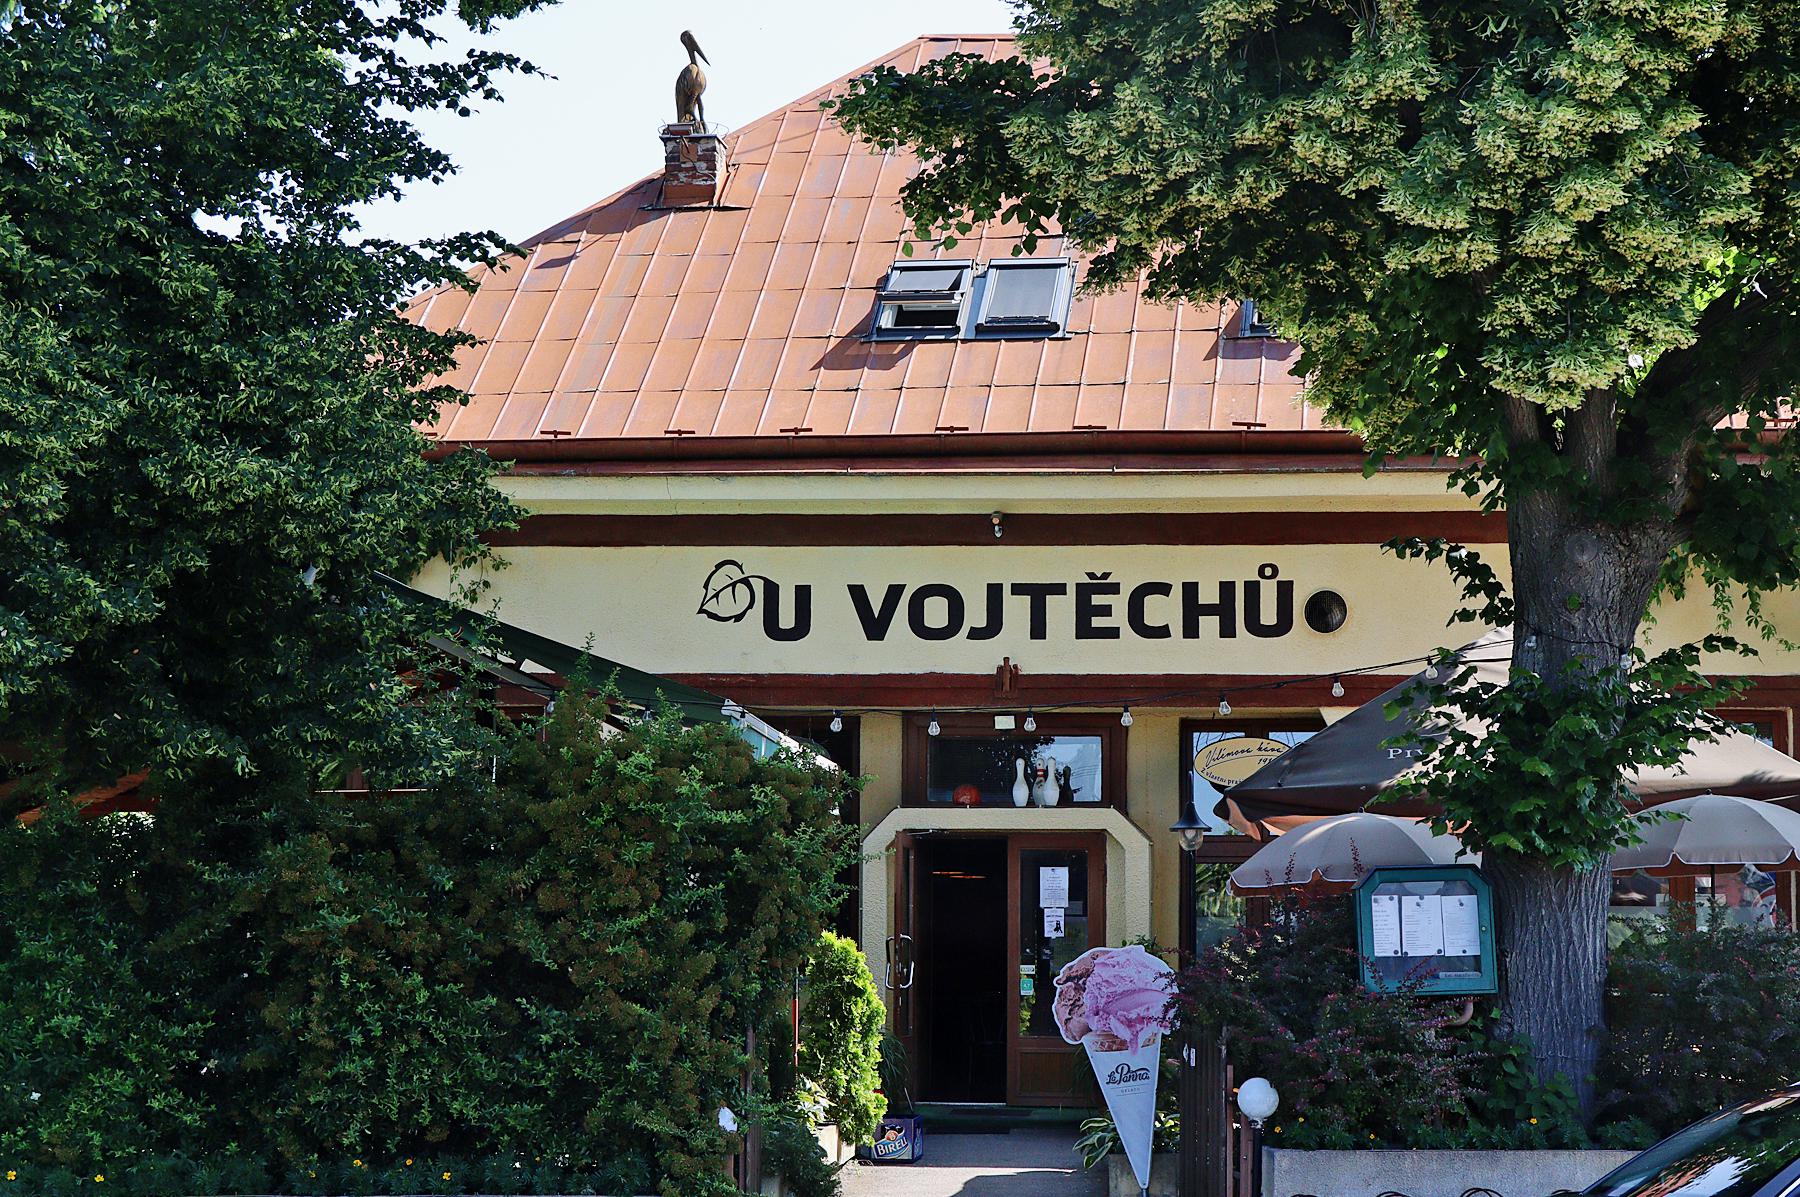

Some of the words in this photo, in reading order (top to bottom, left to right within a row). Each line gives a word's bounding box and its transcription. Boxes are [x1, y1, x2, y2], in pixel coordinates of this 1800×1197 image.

[763, 584, 812, 642] U
[846, 562, 1295, 642] VOJTĚCHŮ
[1115, 1063, 1151, 1085] Panna
[876, 1136, 908, 1156] BIRELL
